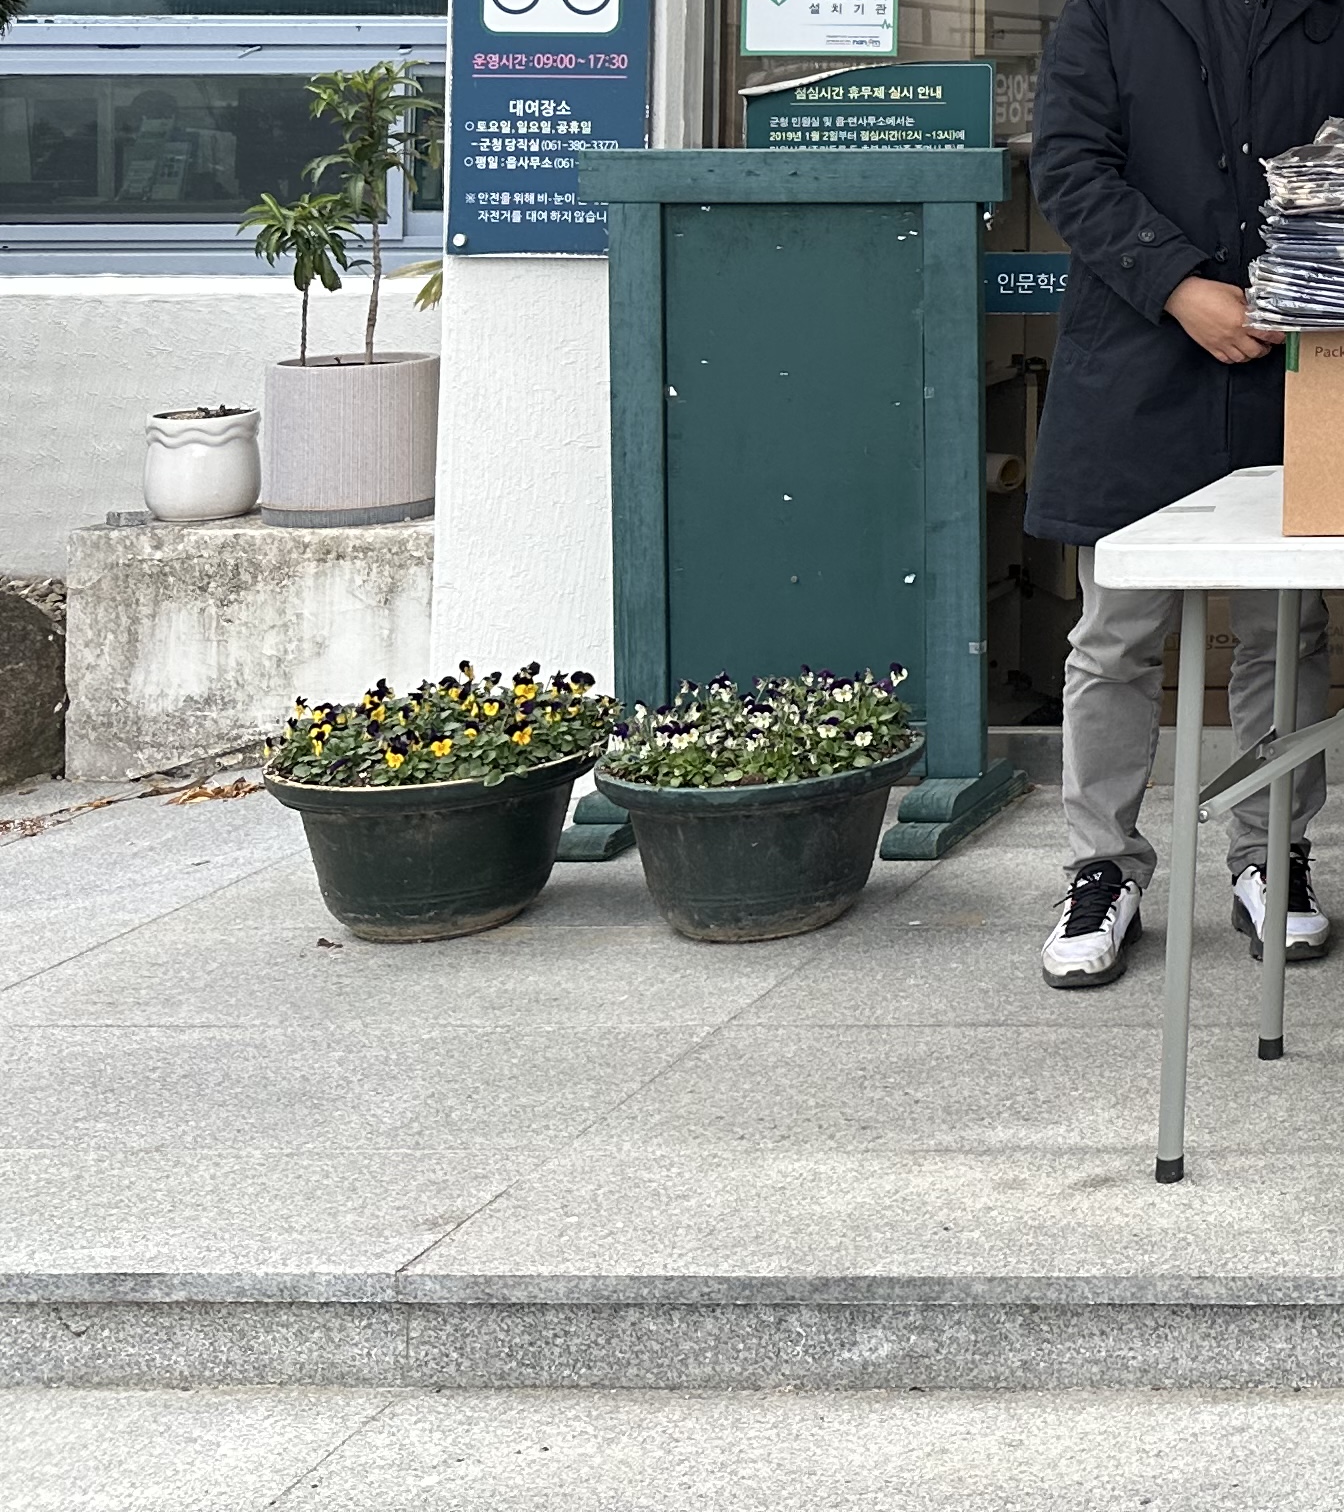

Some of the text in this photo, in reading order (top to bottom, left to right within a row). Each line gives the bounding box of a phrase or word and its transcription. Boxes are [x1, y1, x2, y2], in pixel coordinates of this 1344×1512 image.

[809, 3, 887, 15] 설치기관
[794, 85, 943, 100] 점심시간 휴무제 실시 안내
[509, 100, 572, 117] 대여장소
[769, 130, 802, 141] 2019년
[477, 192, 512, 205] 안전을
[513, 192, 535, 205] 위해
[477, 210, 523, 223] 자전거를
[526, 210, 549, 223] 대여
[550, 210, 572, 223] 하지
